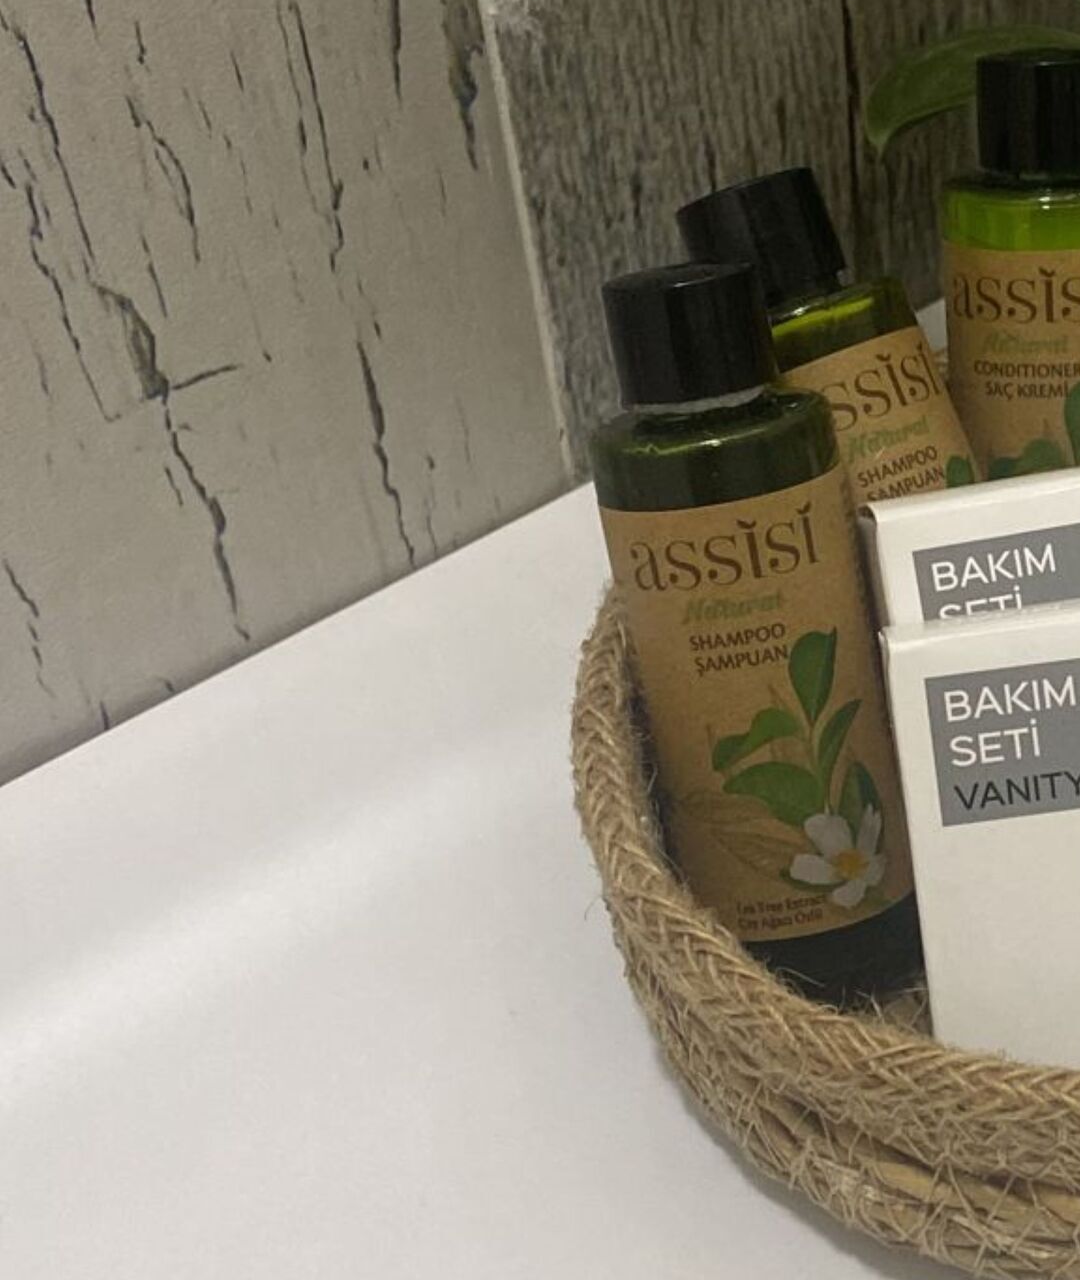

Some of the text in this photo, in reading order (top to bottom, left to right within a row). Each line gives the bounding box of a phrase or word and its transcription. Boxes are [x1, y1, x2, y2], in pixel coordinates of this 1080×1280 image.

[820, 342, 941, 432] ssisi
[986, 381, 1014, 401] SAÇ
[857, 445, 938, 488] SHAMPOO
[630, 501, 820, 591] assisi
[931, 543, 1056, 592] BAKIM
[689, 623, 786, 652] SHAMPOO
[695, 644, 788, 678] ŞAMPUAN
[943, 675, 1077, 723] BAKIM
[949, 718, 1041, 768] SETİ
